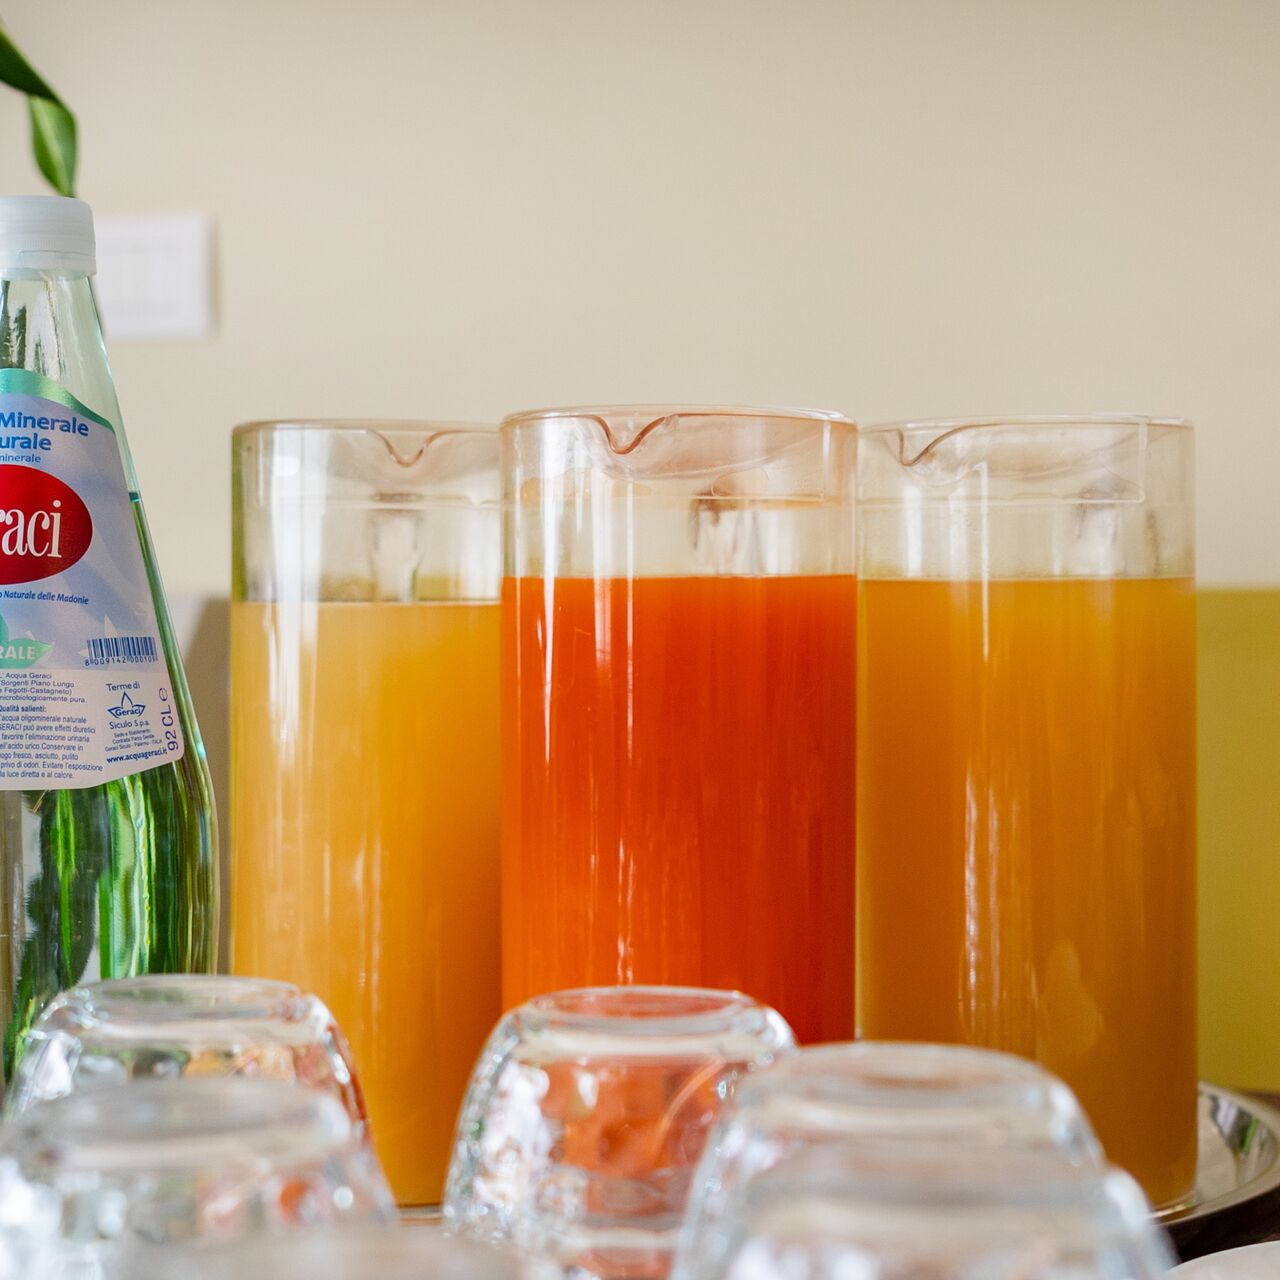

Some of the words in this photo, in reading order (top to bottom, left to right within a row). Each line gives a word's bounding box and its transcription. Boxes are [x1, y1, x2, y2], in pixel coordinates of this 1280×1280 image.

[4, 590, 36, 599] Naturale
[37, 591, 55, 601] delle
[57, 593, 89, 605] Madonie
[5, 672, 27, 680] Acqua
[106, 682, 132, 691] Terme
[132, 681, 140, 689] di
[115, 708, 140, 716] Geraci
[161, 704, 174, 727] CL
[109, 720, 133, 729] Siculo
[165, 729, 179, 751] 92
[106, 747, 167, 763] www.acquageraci.it
